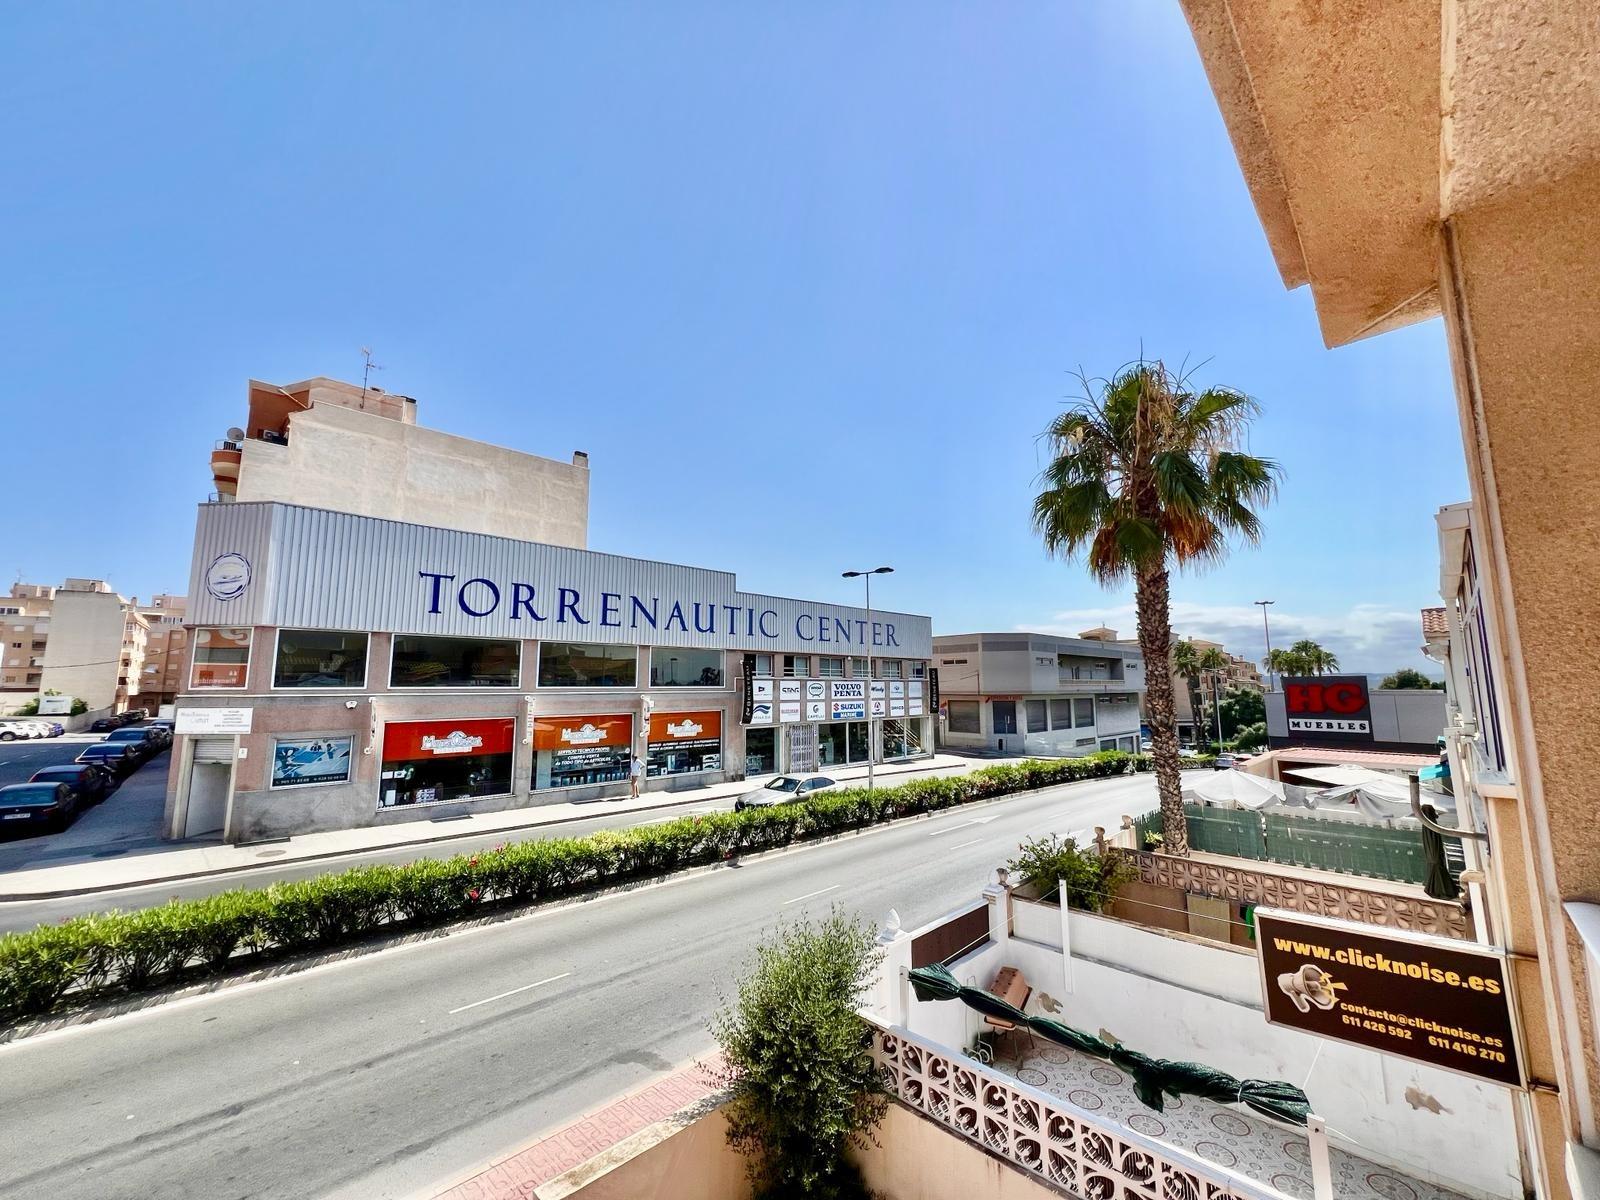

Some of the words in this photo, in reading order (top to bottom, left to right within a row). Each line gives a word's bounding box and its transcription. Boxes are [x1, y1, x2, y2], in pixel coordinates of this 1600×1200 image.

[418, 571, 780, 639] TORRENAUTIC
[795, 614, 900, 647] CENTER
[1291, 720, 1367, 731] MUEBLES
[1273, 937, 1501, 995] www.clicknoise.es
[1340, 1001, 1503, 1048] contacto@clicknoise.es
[1342, 1015, 1364, 1030] 611
[1364, 1019, 1386, 1035] 426
[1388, 1024, 1413, 1040] 592
[1428, 1035, 1451, 1051] 611
[1452, 1040, 1477, 1056] 416
[1479, 1047, 1506, 1064] 270
